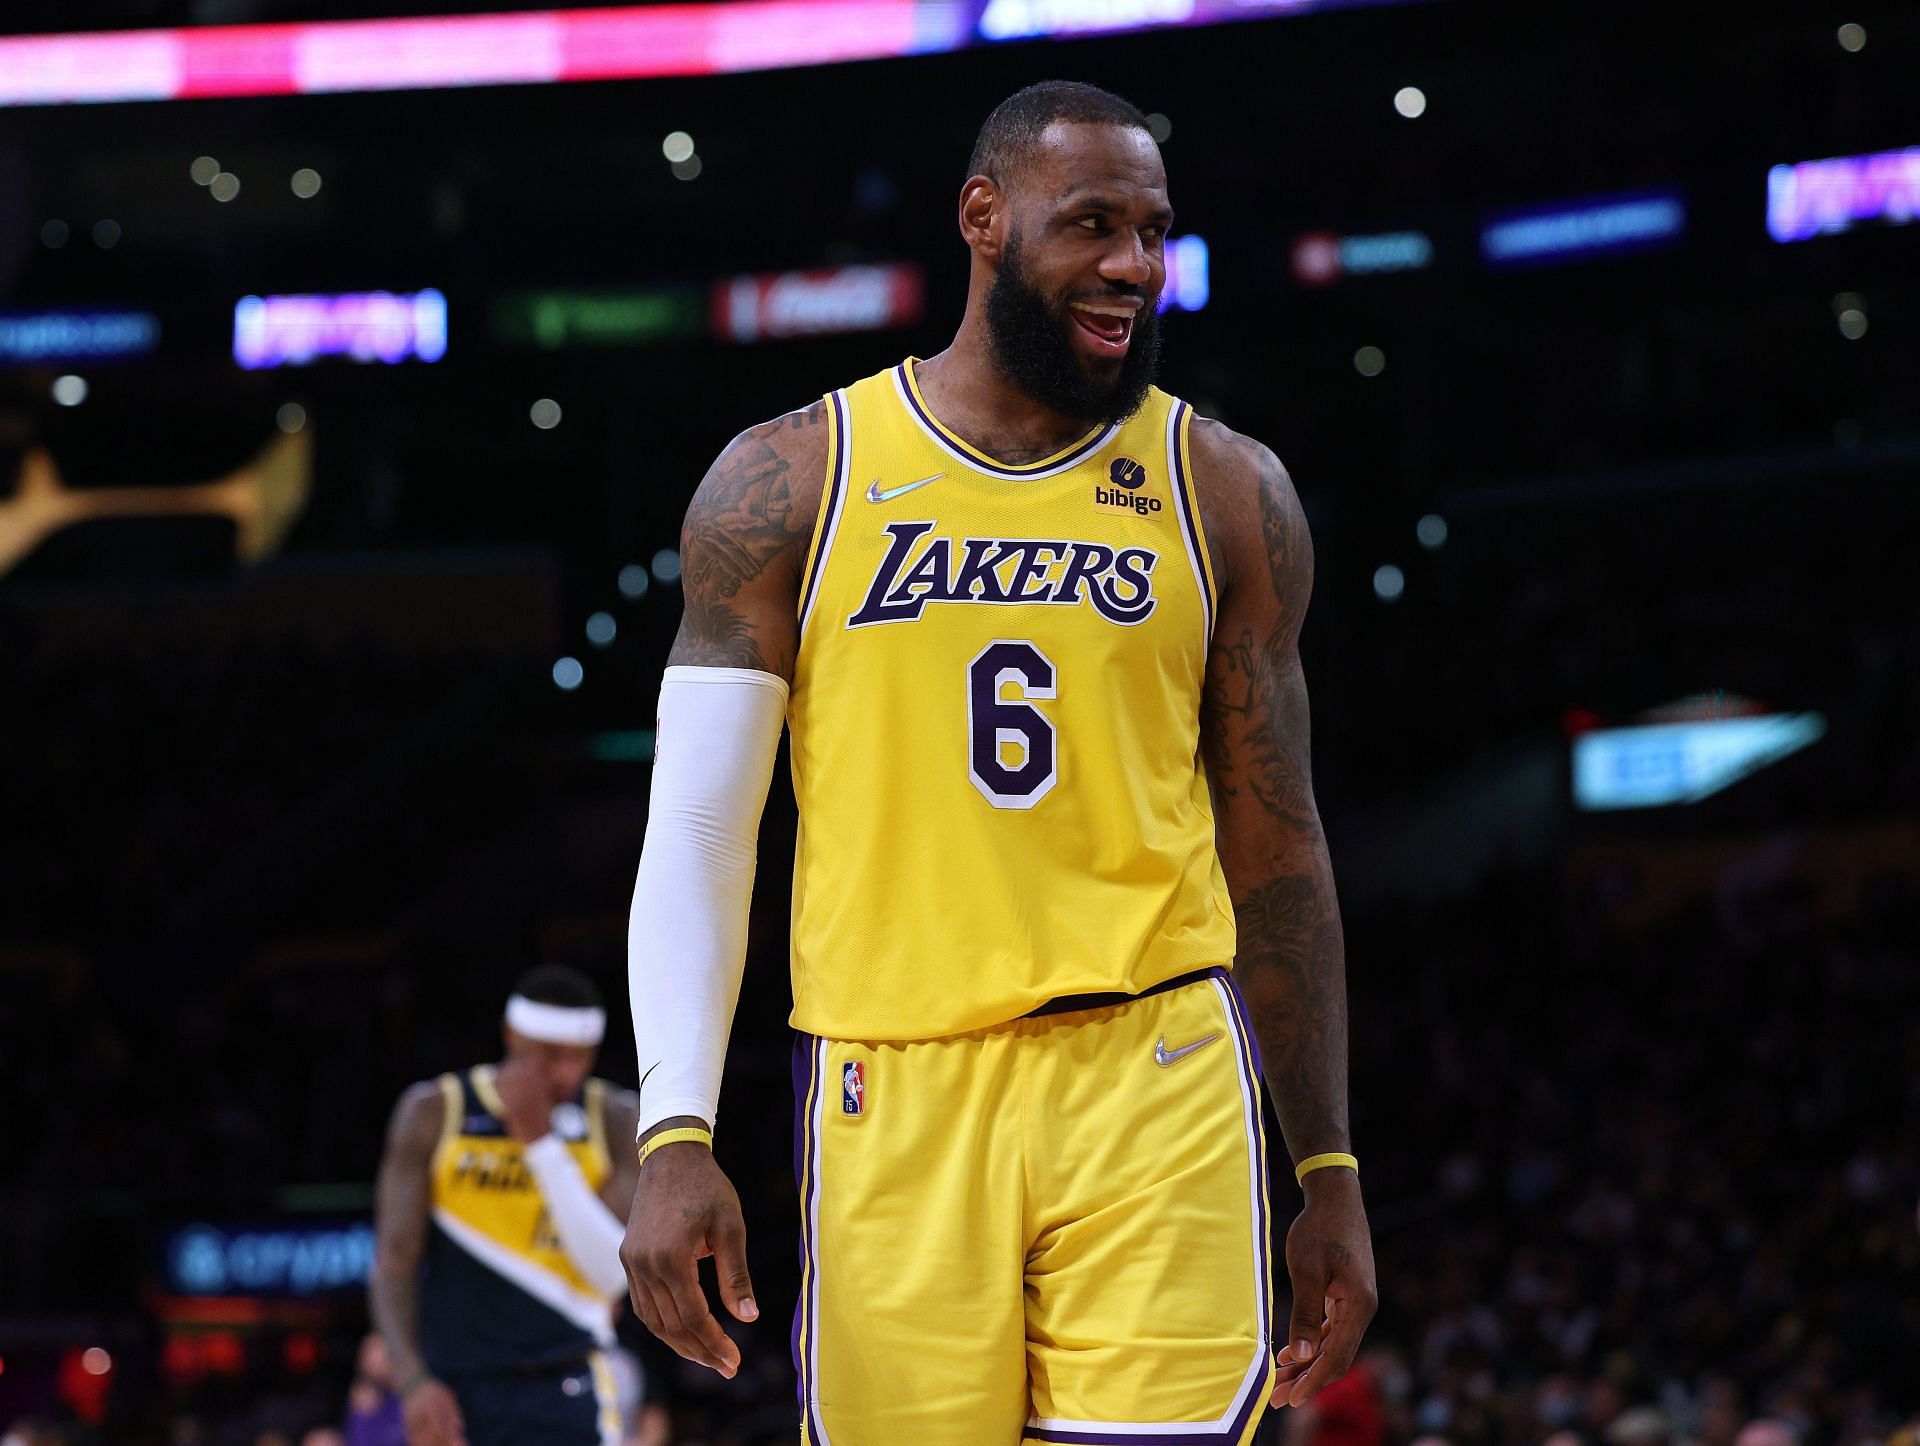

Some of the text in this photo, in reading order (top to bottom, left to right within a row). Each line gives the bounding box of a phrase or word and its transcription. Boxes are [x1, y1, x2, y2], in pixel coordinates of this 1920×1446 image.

[1096, 486, 1162, 516] bibigo
[844, 519, 1160, 630] LAKERS
[966, 639, 1057, 810] 6
[845, 1100, 853, 1112] 75
